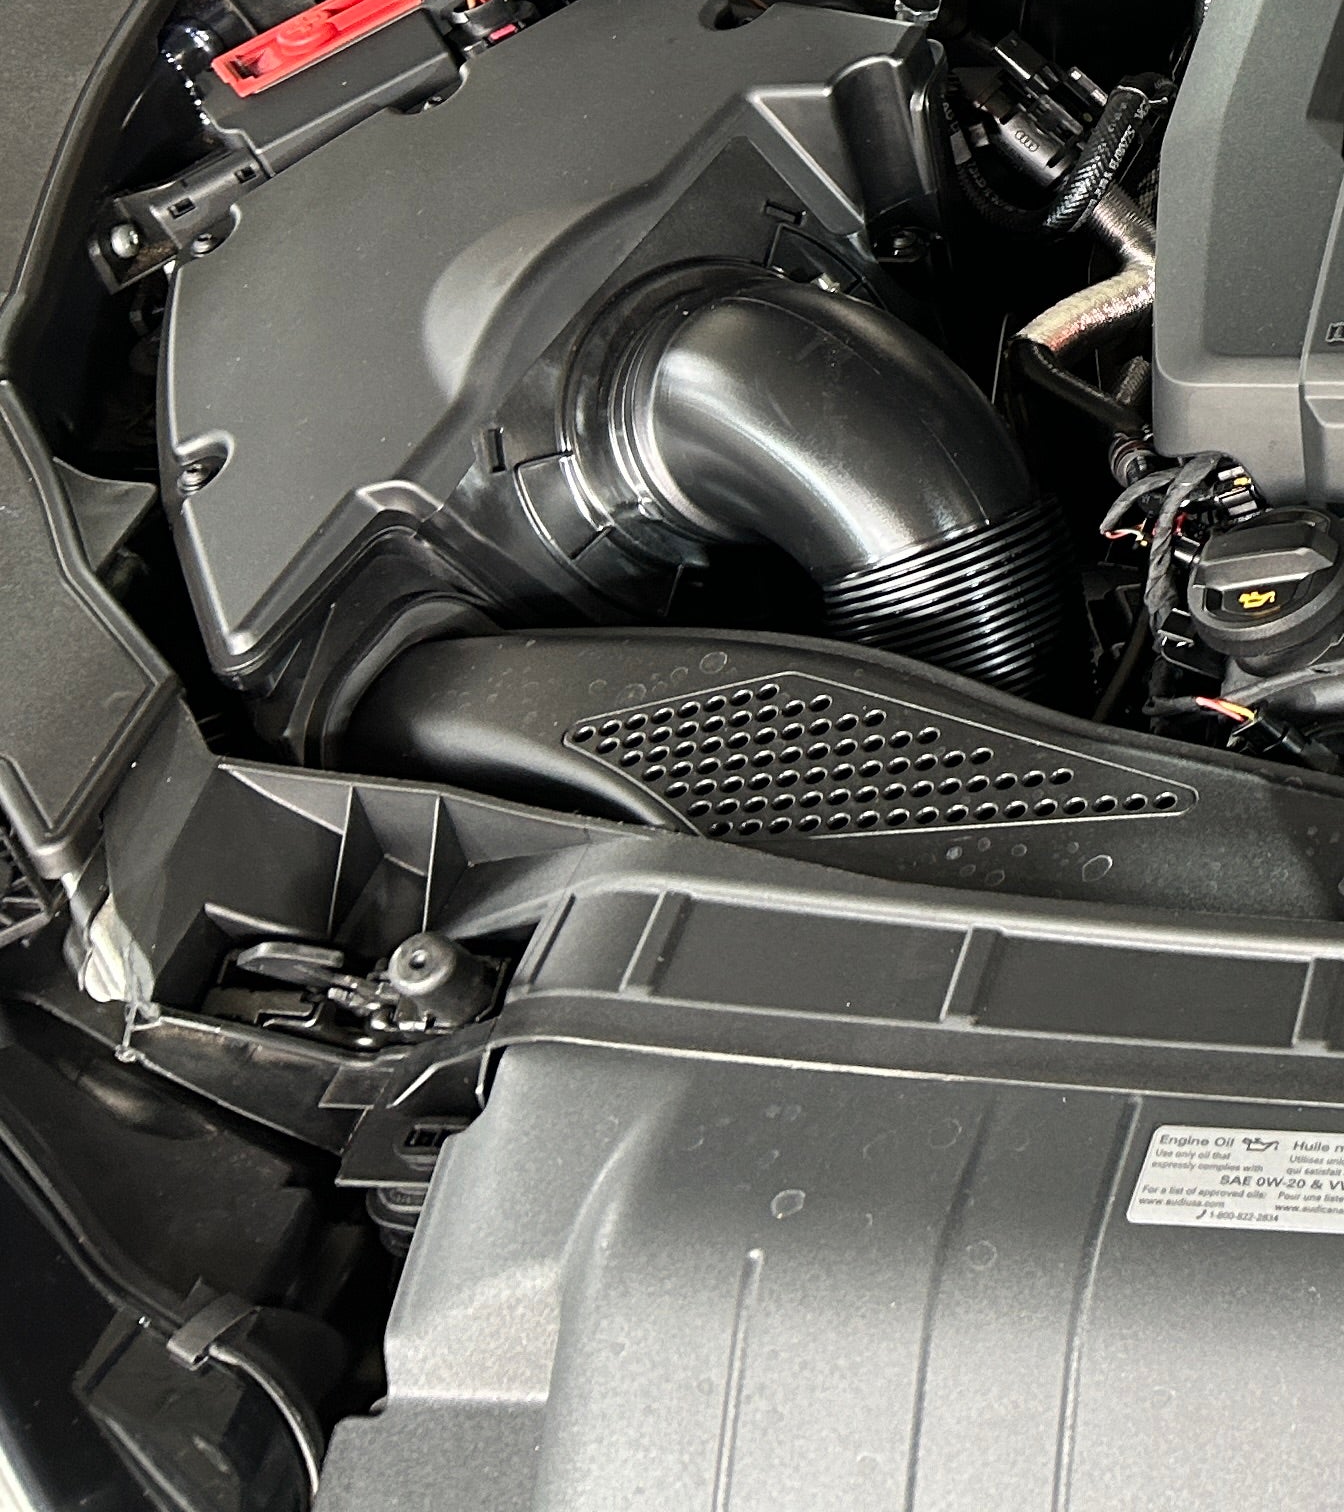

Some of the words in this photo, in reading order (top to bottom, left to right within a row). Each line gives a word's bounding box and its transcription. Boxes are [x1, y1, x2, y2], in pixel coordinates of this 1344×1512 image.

[1159, 1134, 1211, 1148] Engine
[1214, 1137, 1235, 1147] Oil
[1293, 1141, 1331, 1152] Huile
[1175, 1150, 1196, 1159] only
[1212, 1152, 1231, 1160] that
[1151, 1160, 1196, 1170] expressly
[1197, 1162, 1241, 1172] complies
[1219, 1175, 1252, 1186] SAE
[1255, 1177, 1307, 1189] 0W-20
[1310, 1180, 1324, 1189] &
[1198, 1188, 1244, 1200] approved
[1278, 1192, 1301, 1200] Pour
[1324, 1194, 1344, 1202] liste
